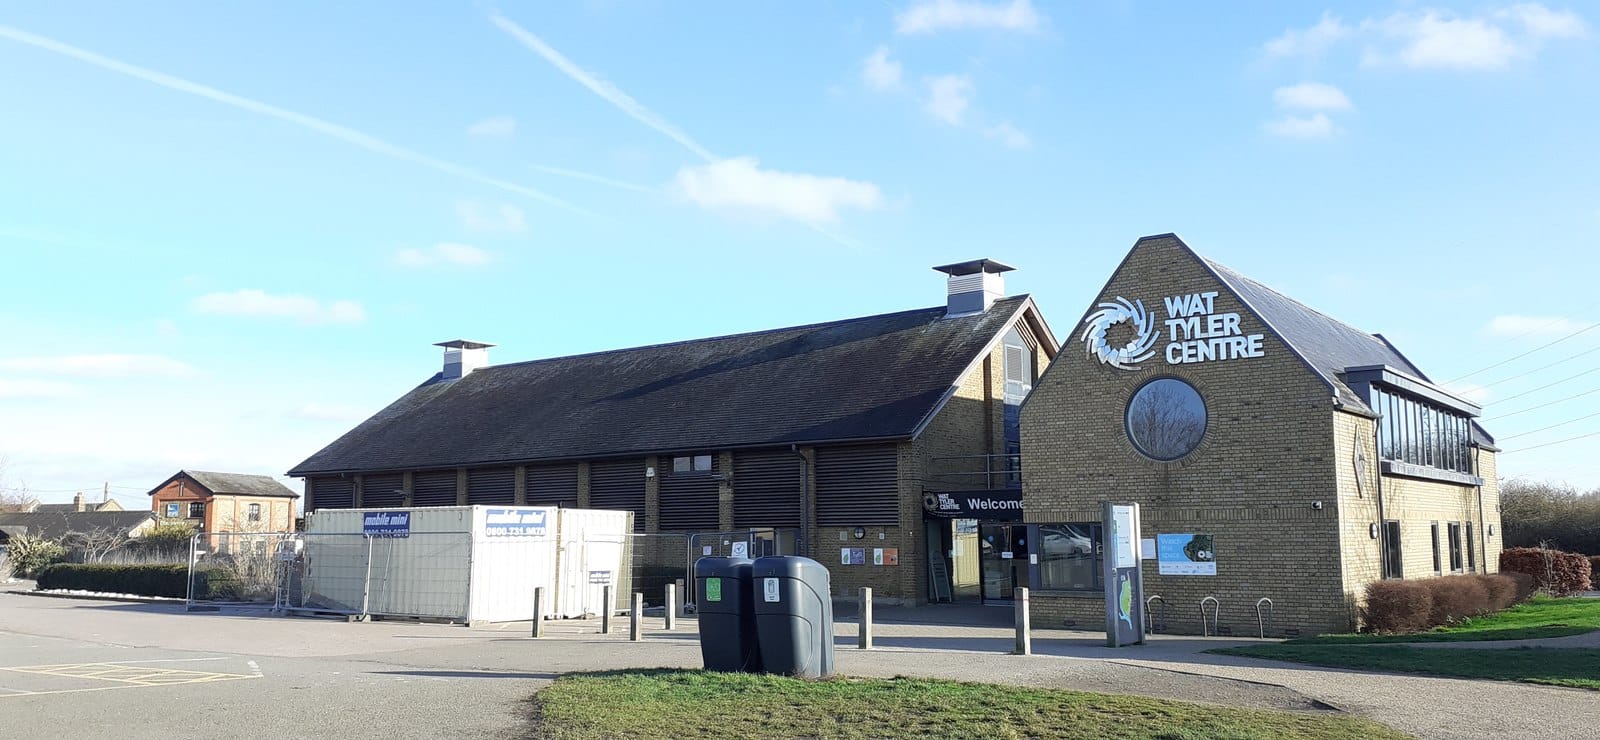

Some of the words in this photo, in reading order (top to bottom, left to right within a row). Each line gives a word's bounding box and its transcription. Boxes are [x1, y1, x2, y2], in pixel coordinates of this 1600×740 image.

[1164, 291, 1219, 318] WAT
[1164, 312, 1243, 341] TYLER
[1165, 334, 1265, 365] CENTRE
[967, 498, 1024, 510] Welcome
[364, 512, 390, 526] mobile
[390, 513, 409, 526] mini
